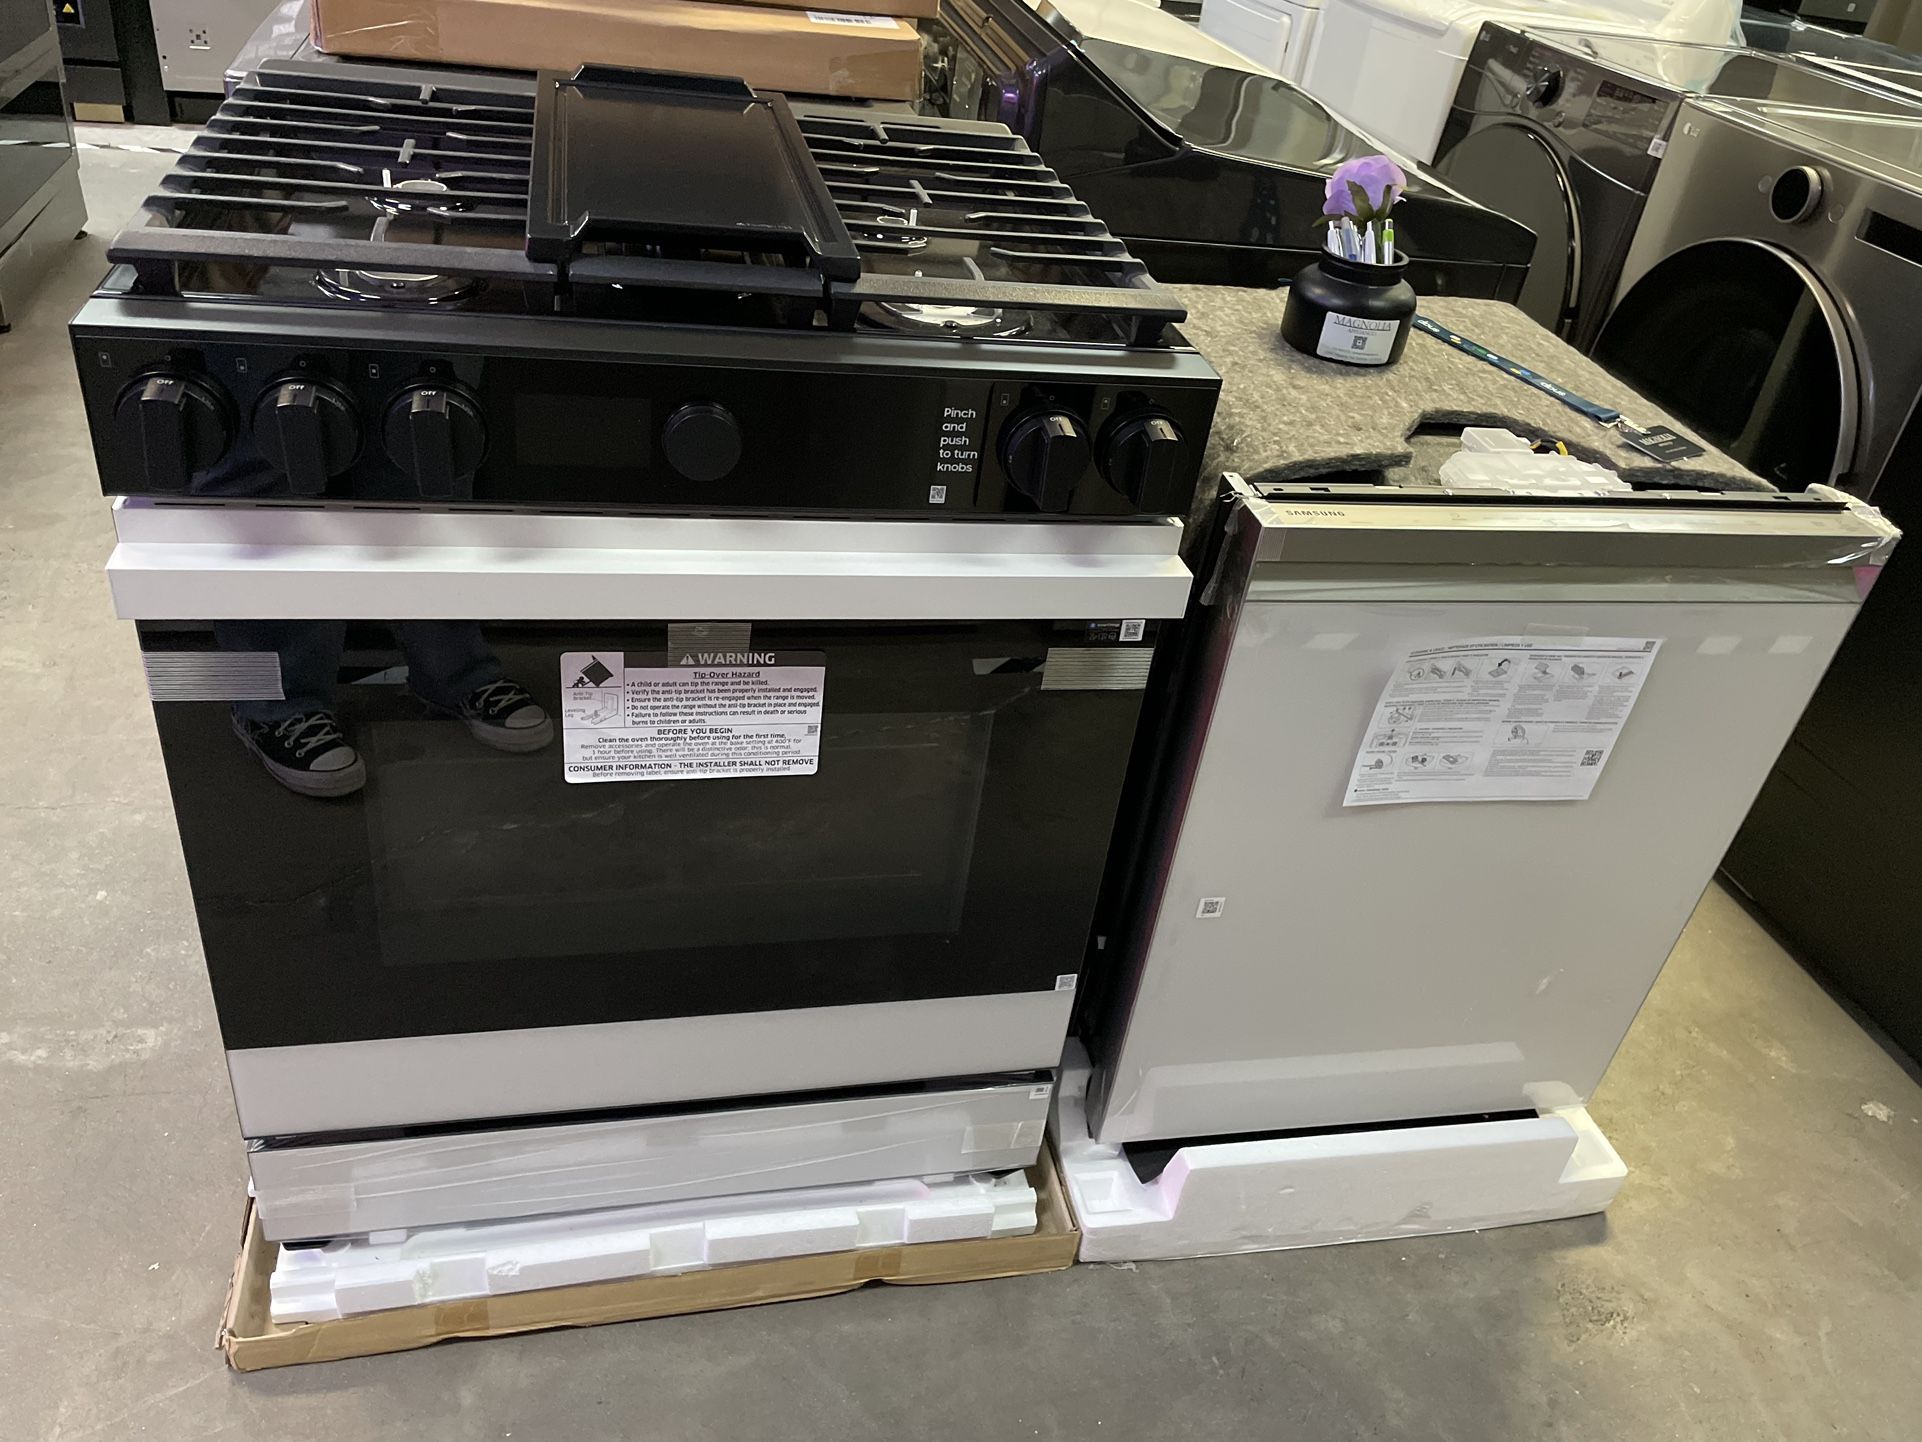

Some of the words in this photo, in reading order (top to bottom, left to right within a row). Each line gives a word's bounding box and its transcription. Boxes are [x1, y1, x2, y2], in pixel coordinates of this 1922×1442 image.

[1334, 315, 1391, 331] MAGNOLIA
[944, 407, 976, 420] Pinch
[942, 422, 966, 433] and
[940, 436, 969, 447] push
[940, 449, 951, 459] to
[954, 450, 978, 459] turn
[937, 462, 973, 472] knobs
[698, 652, 775, 665] WARNING
[568, 764, 614, 772] CONSUMER
[696, 760, 737, 768] INSTALLER
